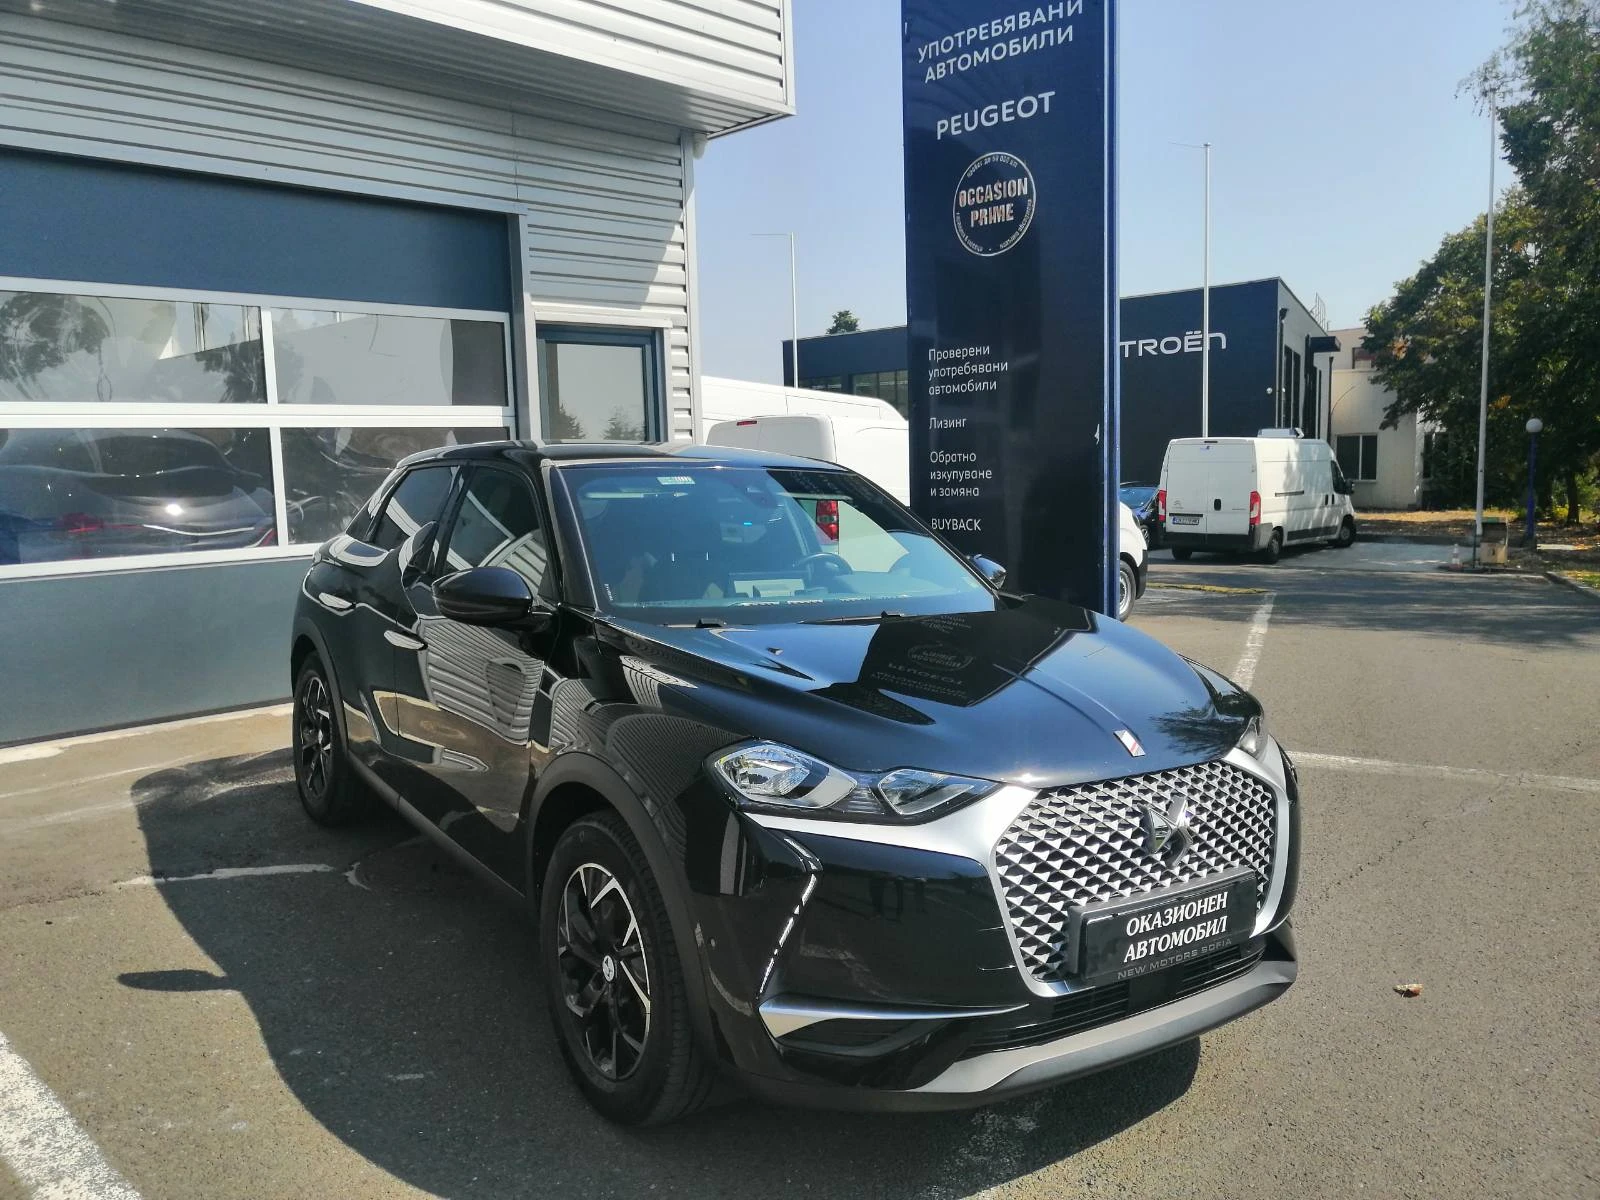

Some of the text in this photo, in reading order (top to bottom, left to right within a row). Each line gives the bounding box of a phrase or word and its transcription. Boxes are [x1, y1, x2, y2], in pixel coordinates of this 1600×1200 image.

[918, 0, 1083, 63] УПОТРЕБЯВАНИ
[924, 25, 1074, 83] АВТОМОБИЛИ
[936, 91, 1056, 140] PEUGEOT
[959, 177, 1028, 208] OCCASION
[970, 203, 1014, 228] PRIME
[928, 345, 990, 362] Проверени
[928, 361, 1008, 381] употребявани
[928, 379, 997, 396] автомобили
[929, 417, 967, 430] Лизинг
[930, 451, 977, 465] Обратно
[930, 470, 993, 482] изкупуване
[930, 486, 980, 497] и замяна
[931, 518, 982, 532] BUYBACK
[1126, 891, 1228, 937] ОКАЗИОНЕН
[1123, 915, 1228, 963] АВТОМОБИЛ
[1117, 938, 1232, 980] NEW MOTORS SOFIA
